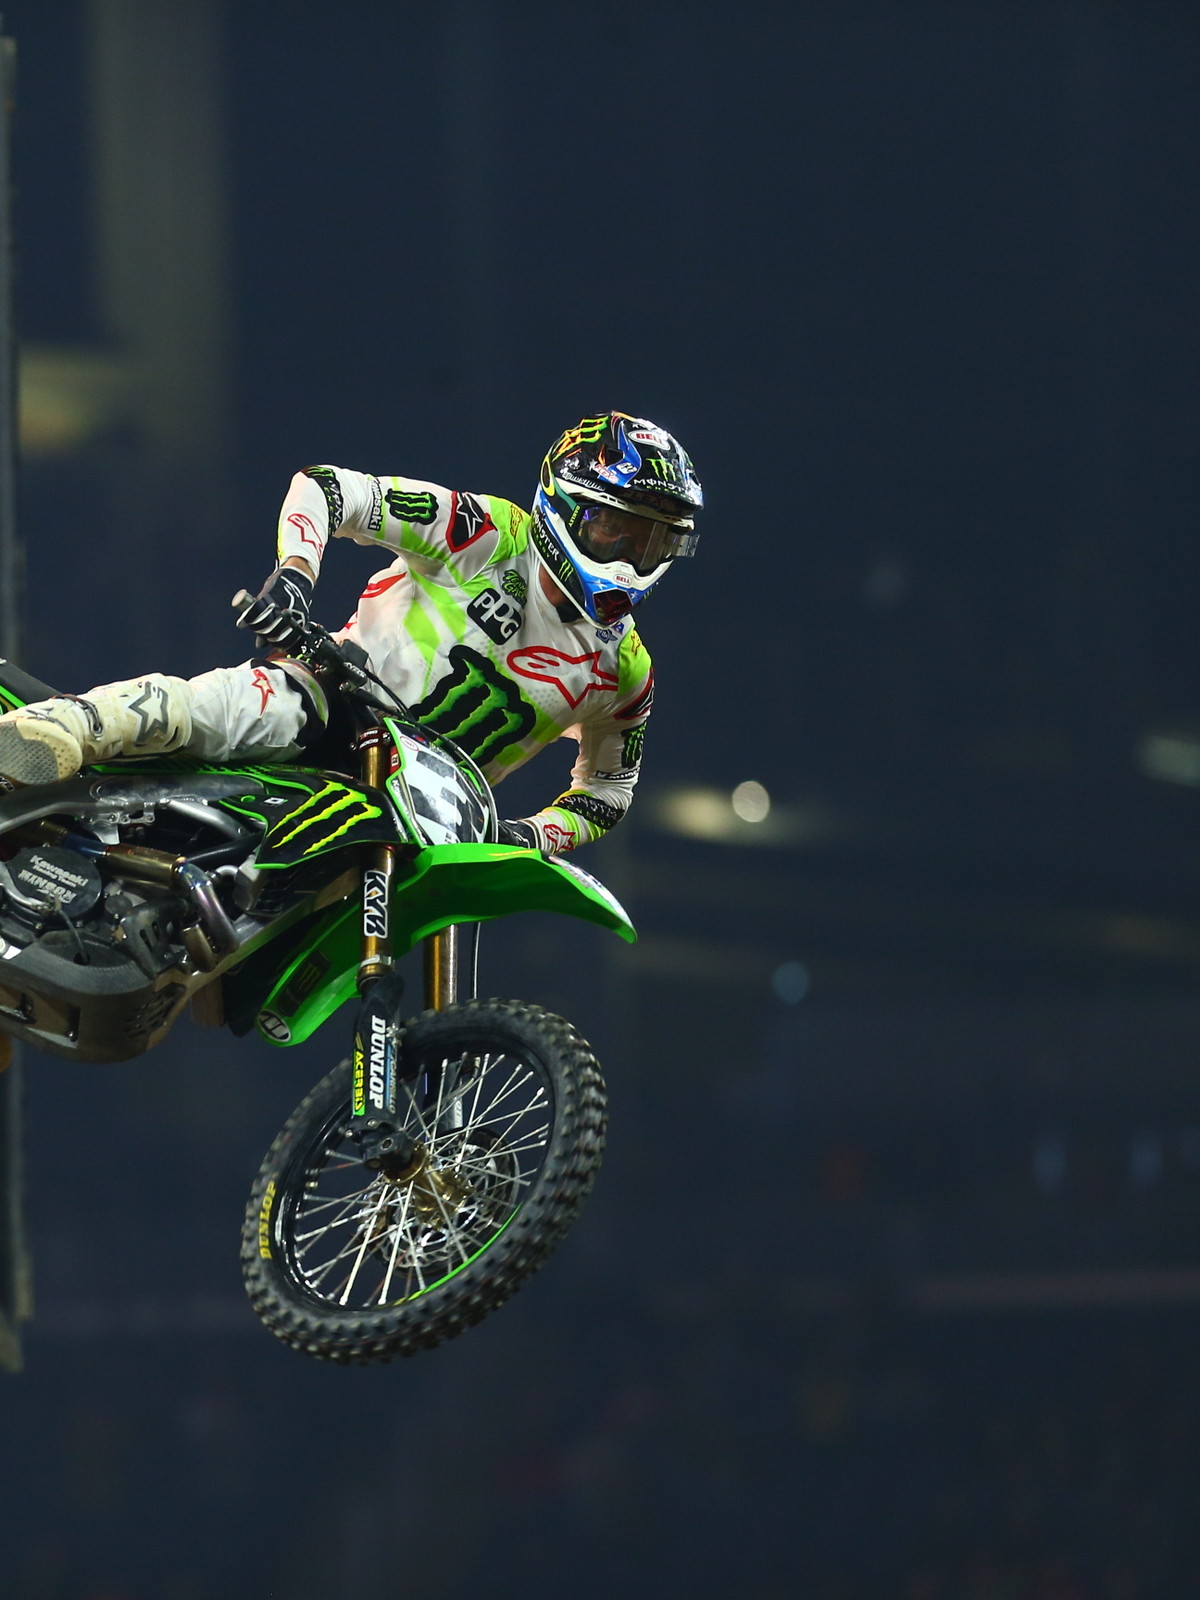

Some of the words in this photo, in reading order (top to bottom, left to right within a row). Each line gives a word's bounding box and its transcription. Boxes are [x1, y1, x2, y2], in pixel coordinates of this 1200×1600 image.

[635, 432, 664, 445] BELL
[615, 575, 630, 584] BELL
[473, 591, 519, 638] PPG
[30, 855, 89, 887] Kawasaki
[364, 870, 389, 939] KYB
[369, 1014, 387, 1110] DUNLOP
[259, 1180, 276, 1259] DUNLOP
